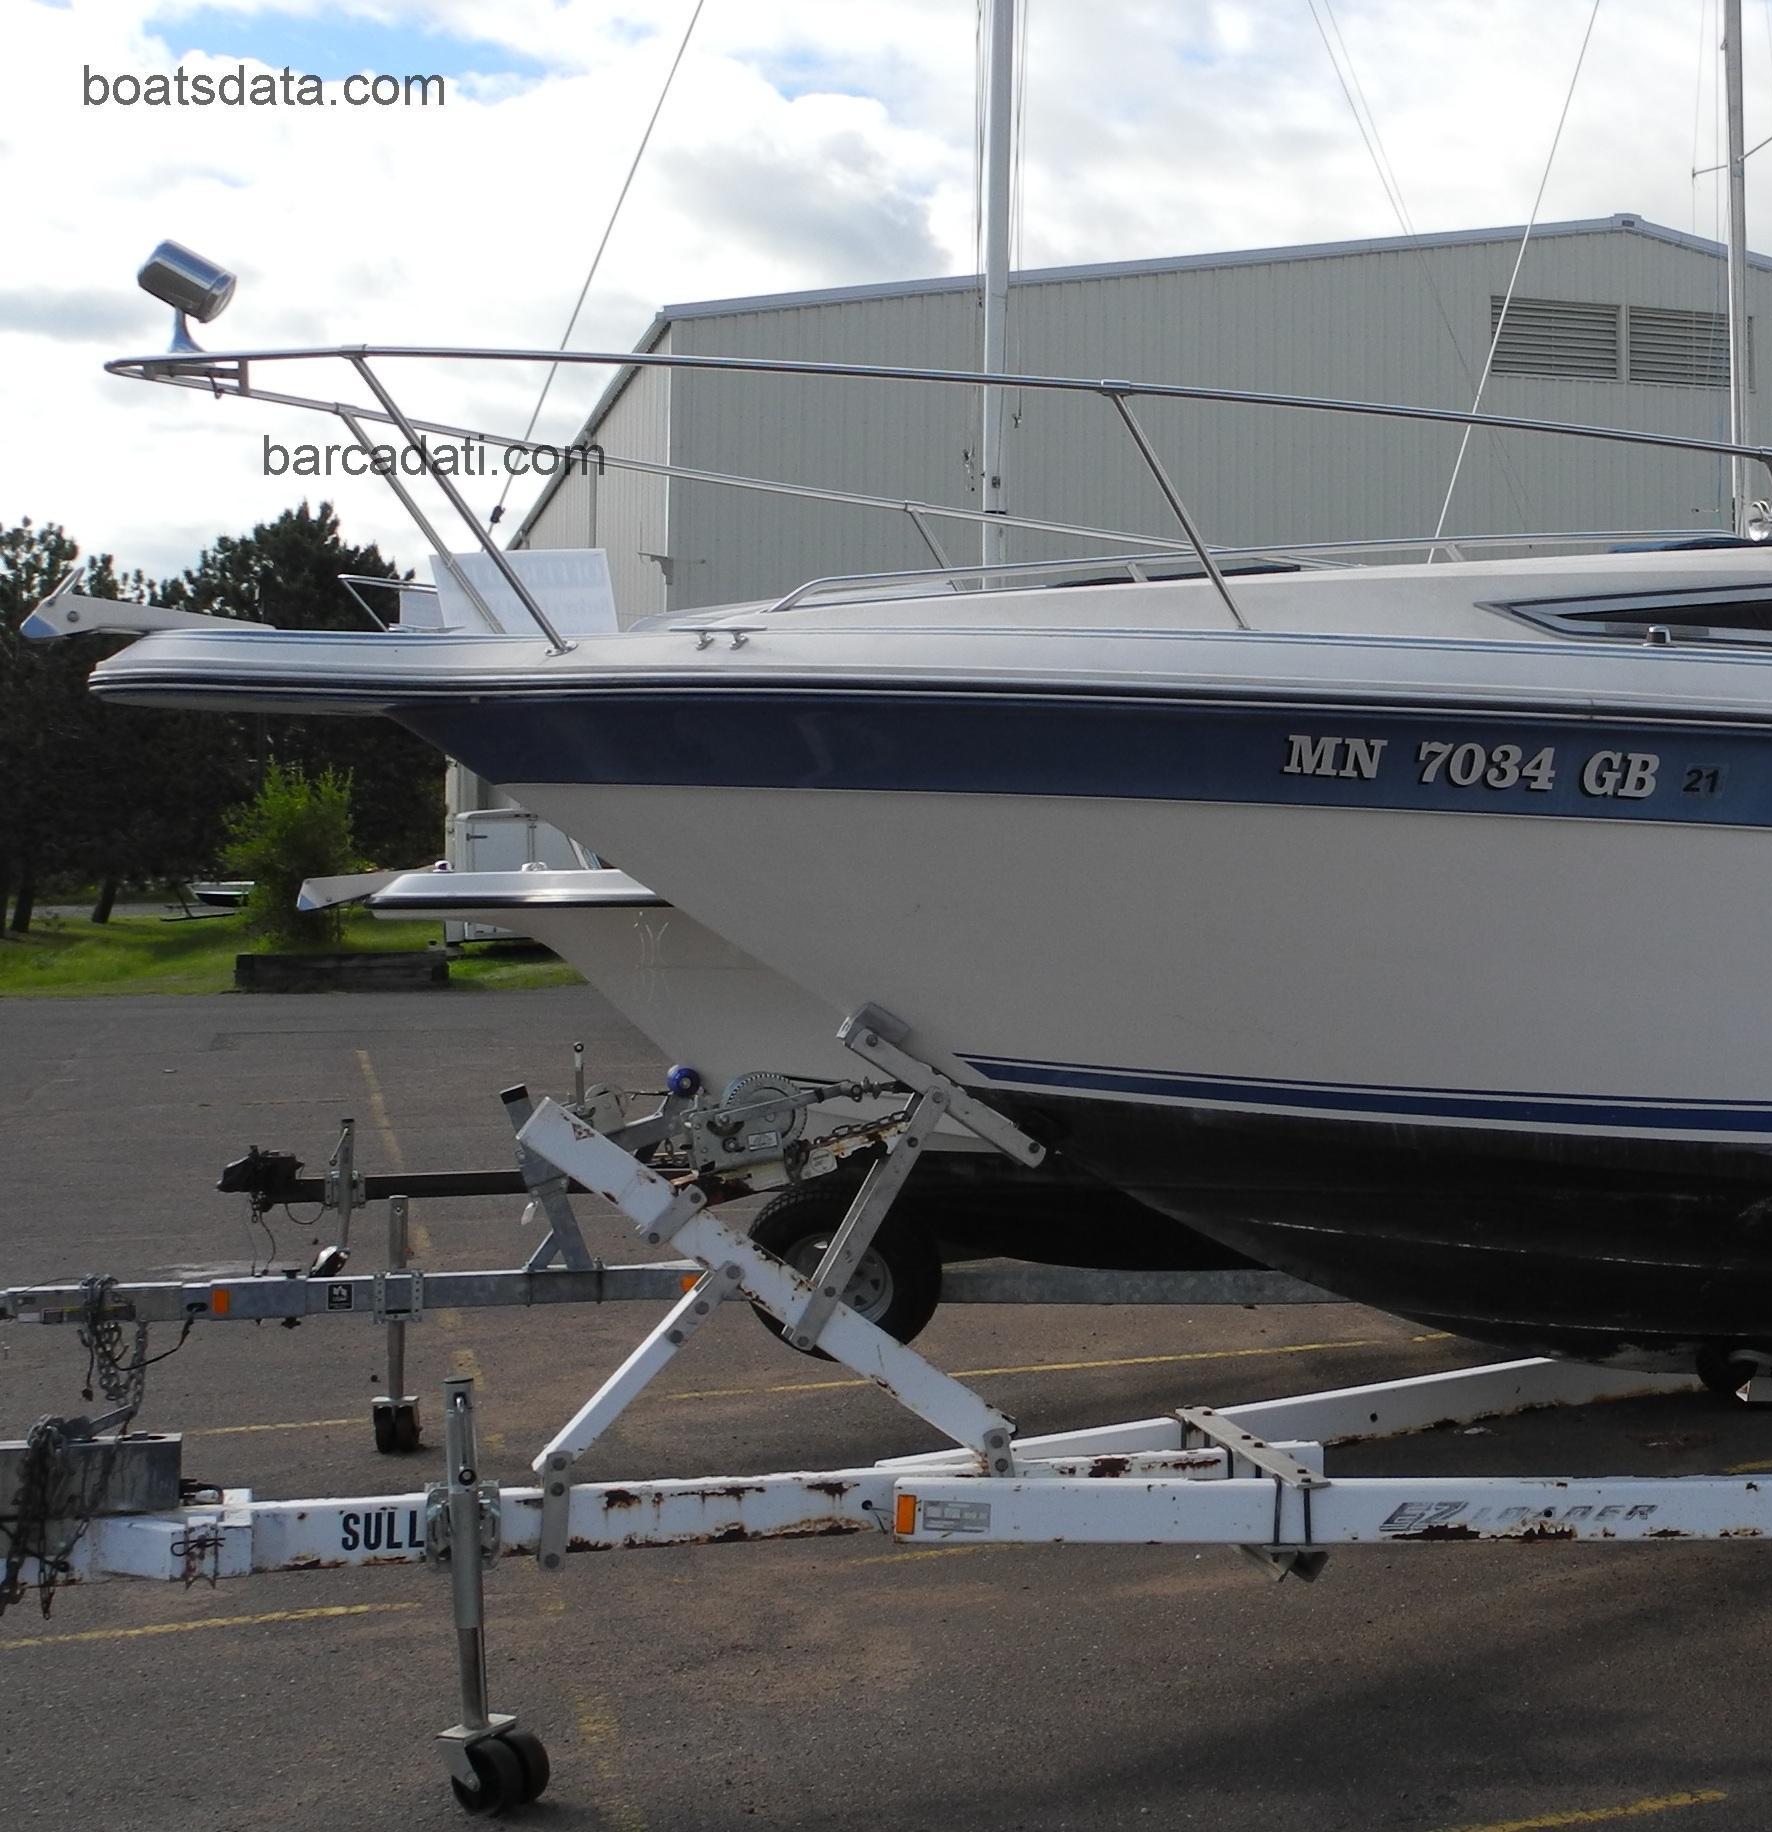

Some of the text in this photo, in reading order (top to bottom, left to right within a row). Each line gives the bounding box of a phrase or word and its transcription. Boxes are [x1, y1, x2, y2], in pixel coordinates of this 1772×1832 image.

[1281, 734, 1661, 799] MN 7034 GB
[1682, 768, 1721, 793] 21
[341, 1510, 425, 1551] SULL
[1379, 1501, 1468, 1531] EZ
